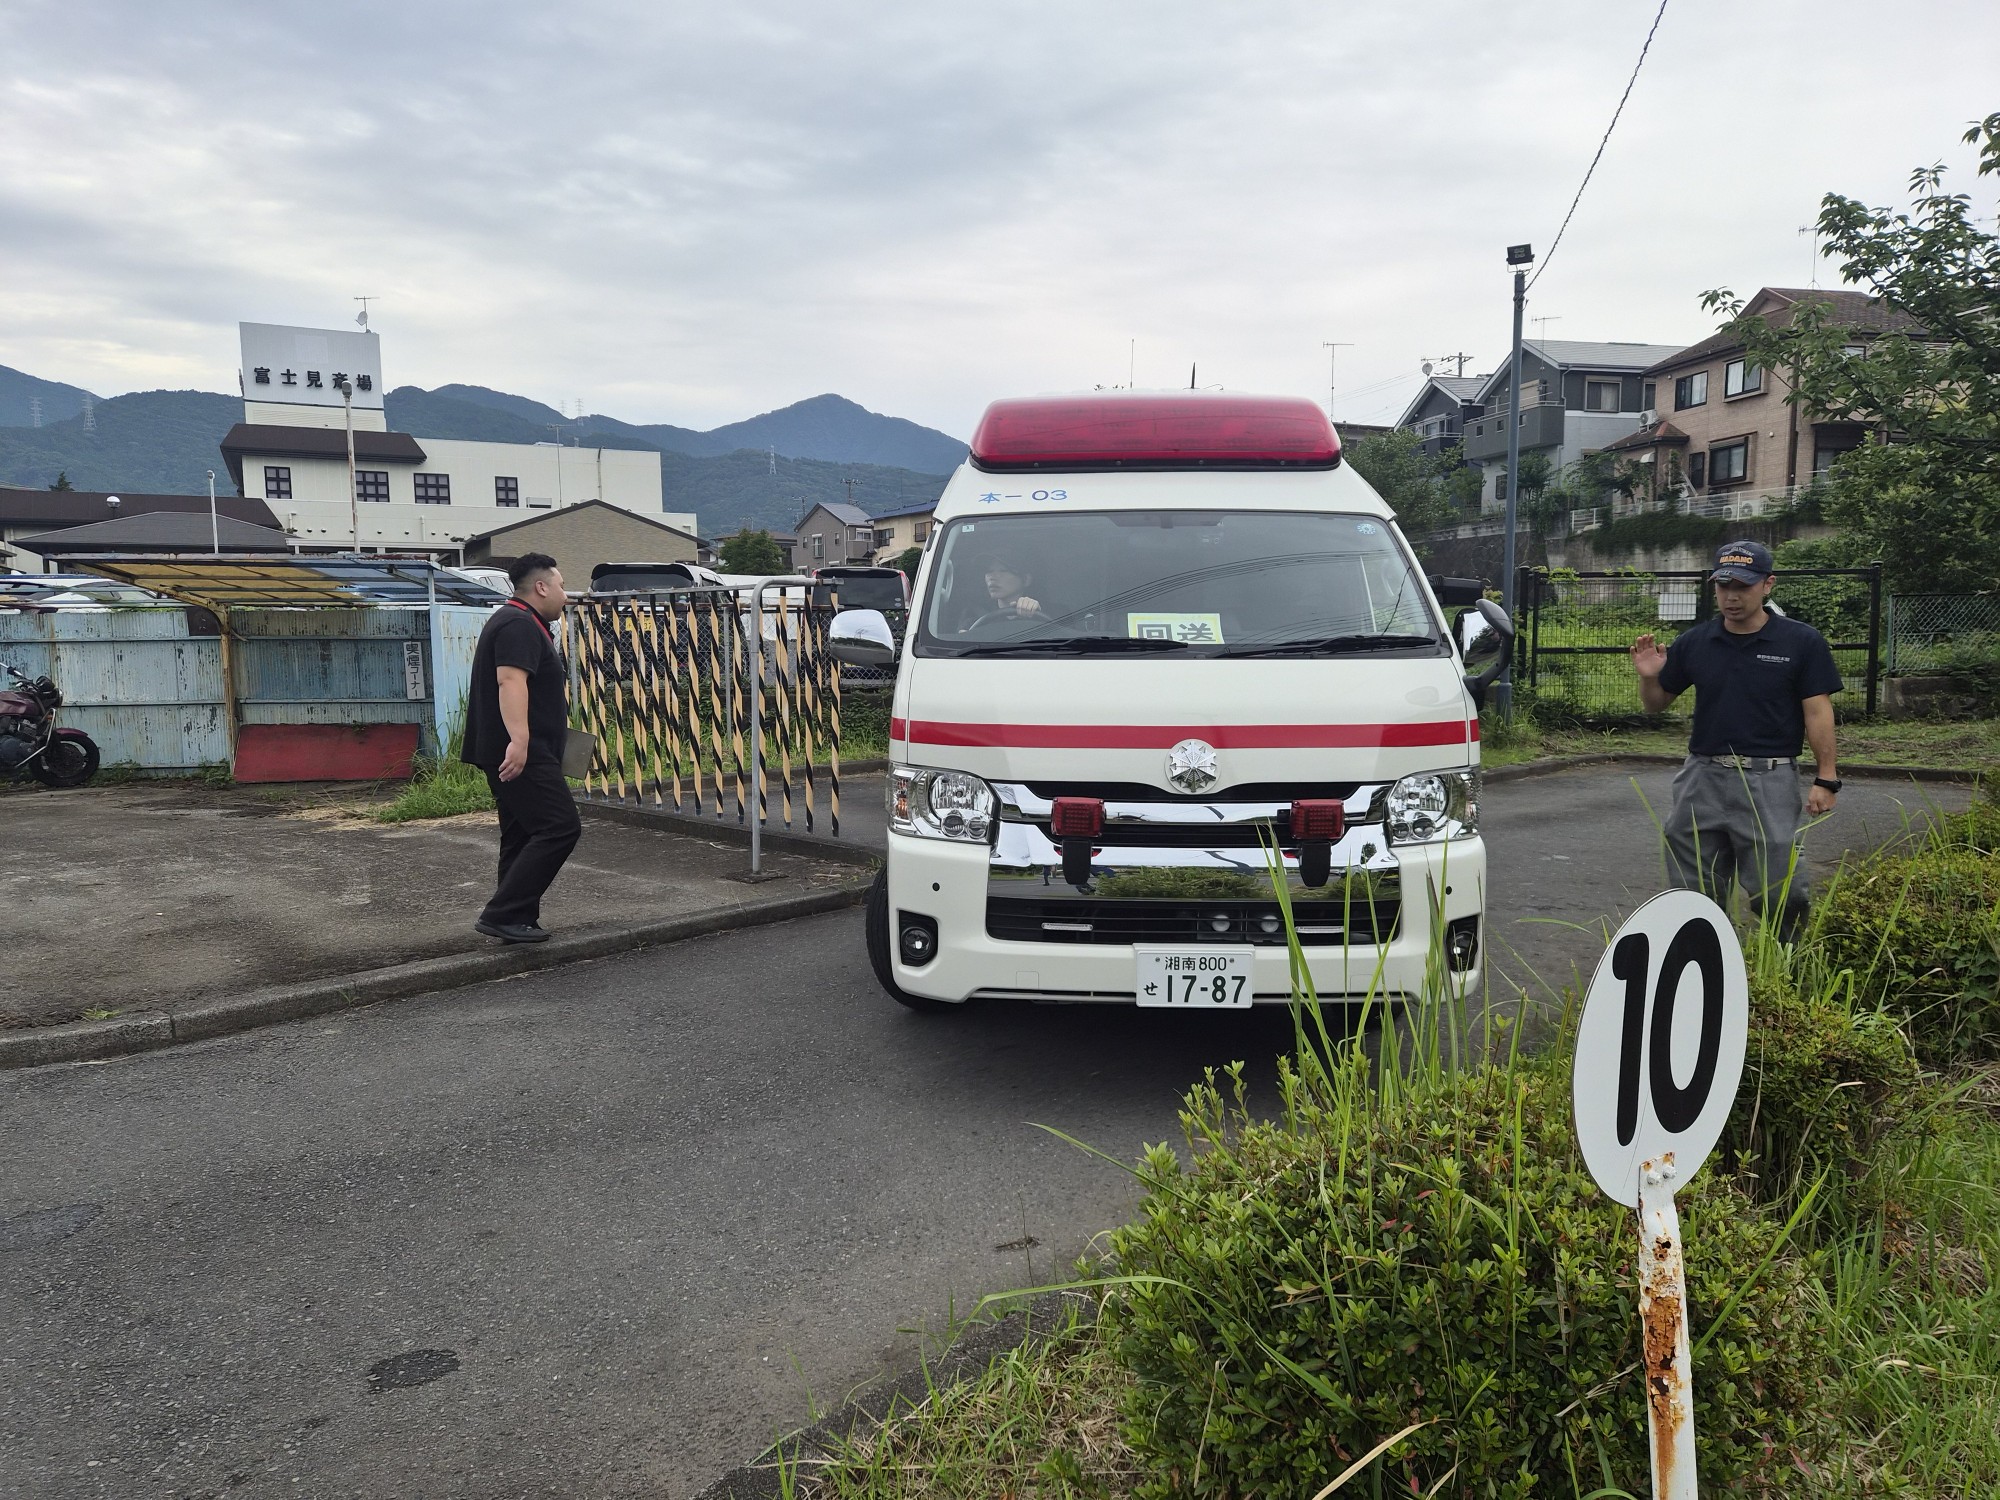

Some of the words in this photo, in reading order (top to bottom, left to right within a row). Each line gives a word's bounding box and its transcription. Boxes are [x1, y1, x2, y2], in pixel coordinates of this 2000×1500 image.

[254, 366, 372, 392] 富士見斎場
[1137, 622, 1216, 642] 回送
[405, 642, 421, 697] 喫煙コーナー
[1143, 981, 1158, 996] せ
[1167, 975, 1247, 1003] 17-87
[1612, 917, 1724, 1147] 10
